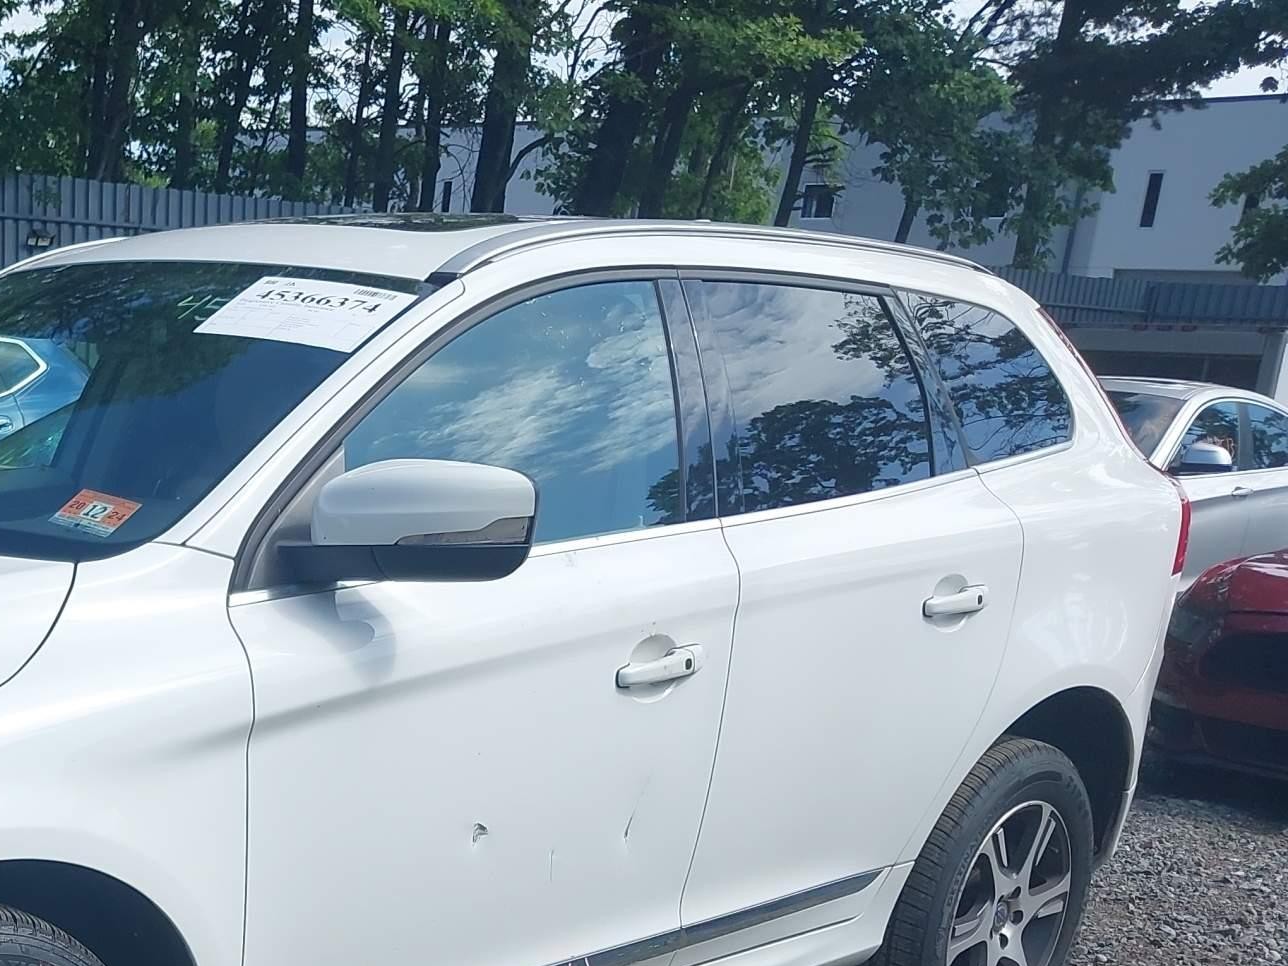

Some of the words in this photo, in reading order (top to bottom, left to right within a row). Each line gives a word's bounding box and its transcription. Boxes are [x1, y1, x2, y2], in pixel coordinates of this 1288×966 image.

[256, 289, 382, 313] 45366374
[69, 500, 86, 510] 20
[82, 504, 108, 519] 12
